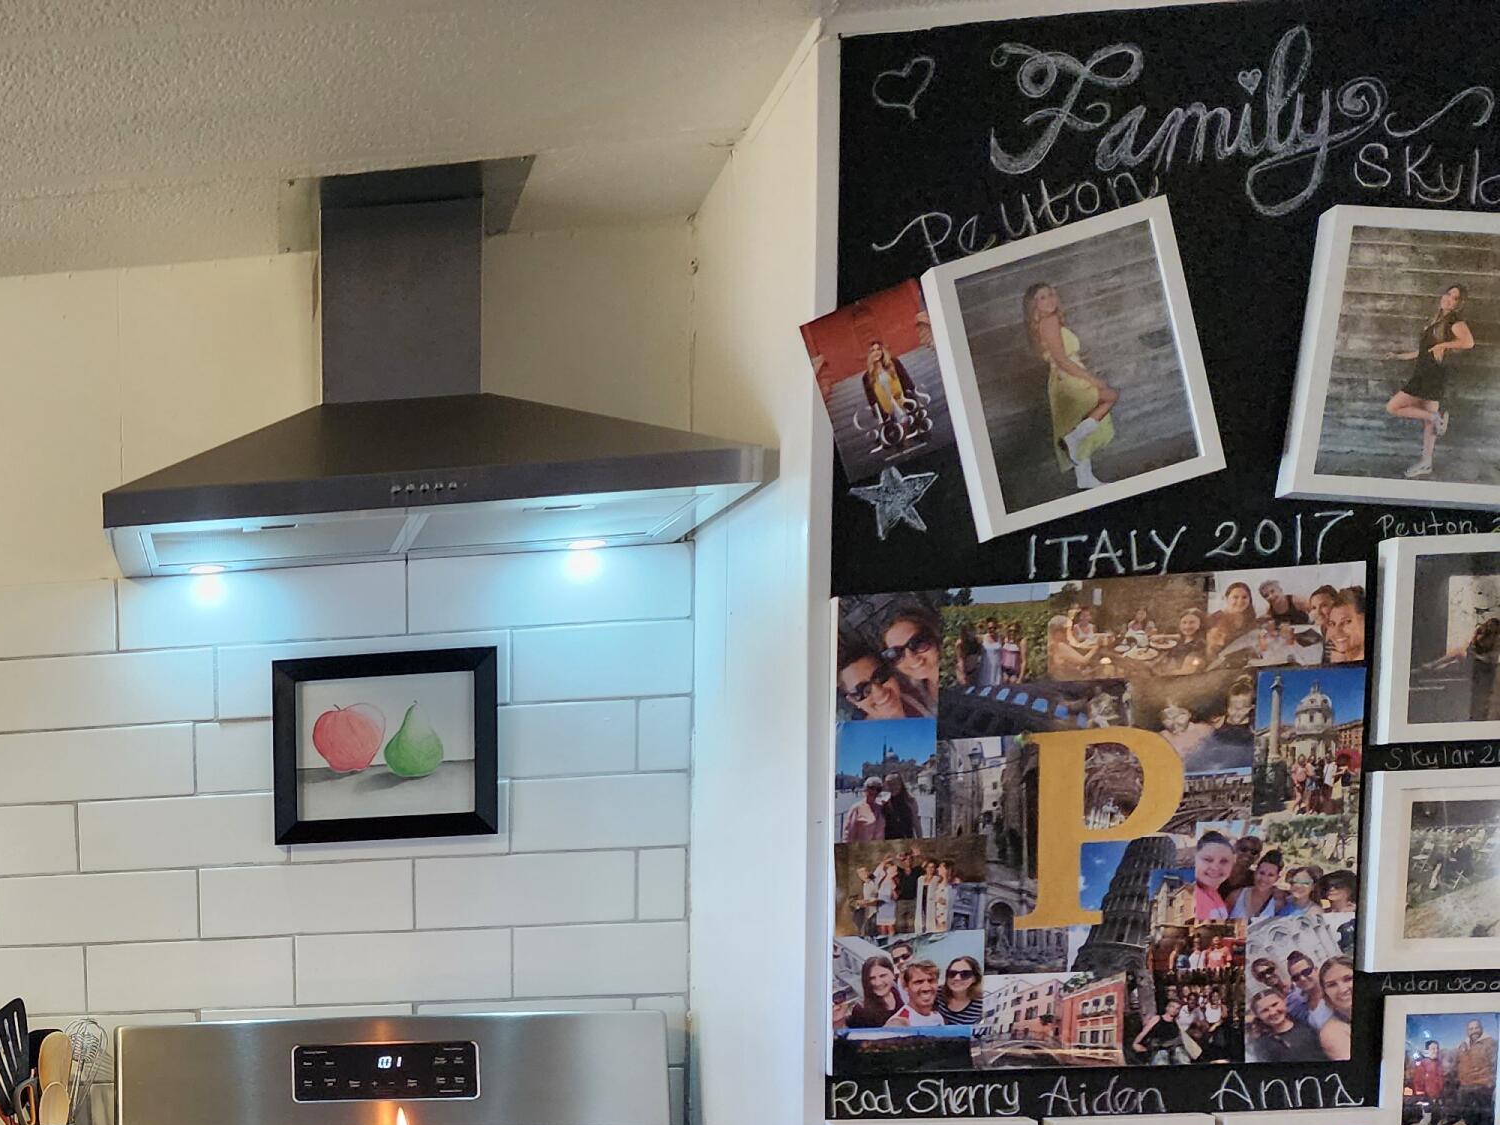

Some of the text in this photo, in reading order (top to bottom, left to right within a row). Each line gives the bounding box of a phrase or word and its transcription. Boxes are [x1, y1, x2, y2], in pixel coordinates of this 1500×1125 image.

[990, 25, 1388, 217] Family
[1028, 509, 1355, 580] ITALY 2017
[1013, 725, 1186, 930] P
[830, 1077, 1022, 1118] Rod Sherry
[1039, 1074, 1167, 1115] Aiden
[1210, 1069, 1366, 1110] Anna
